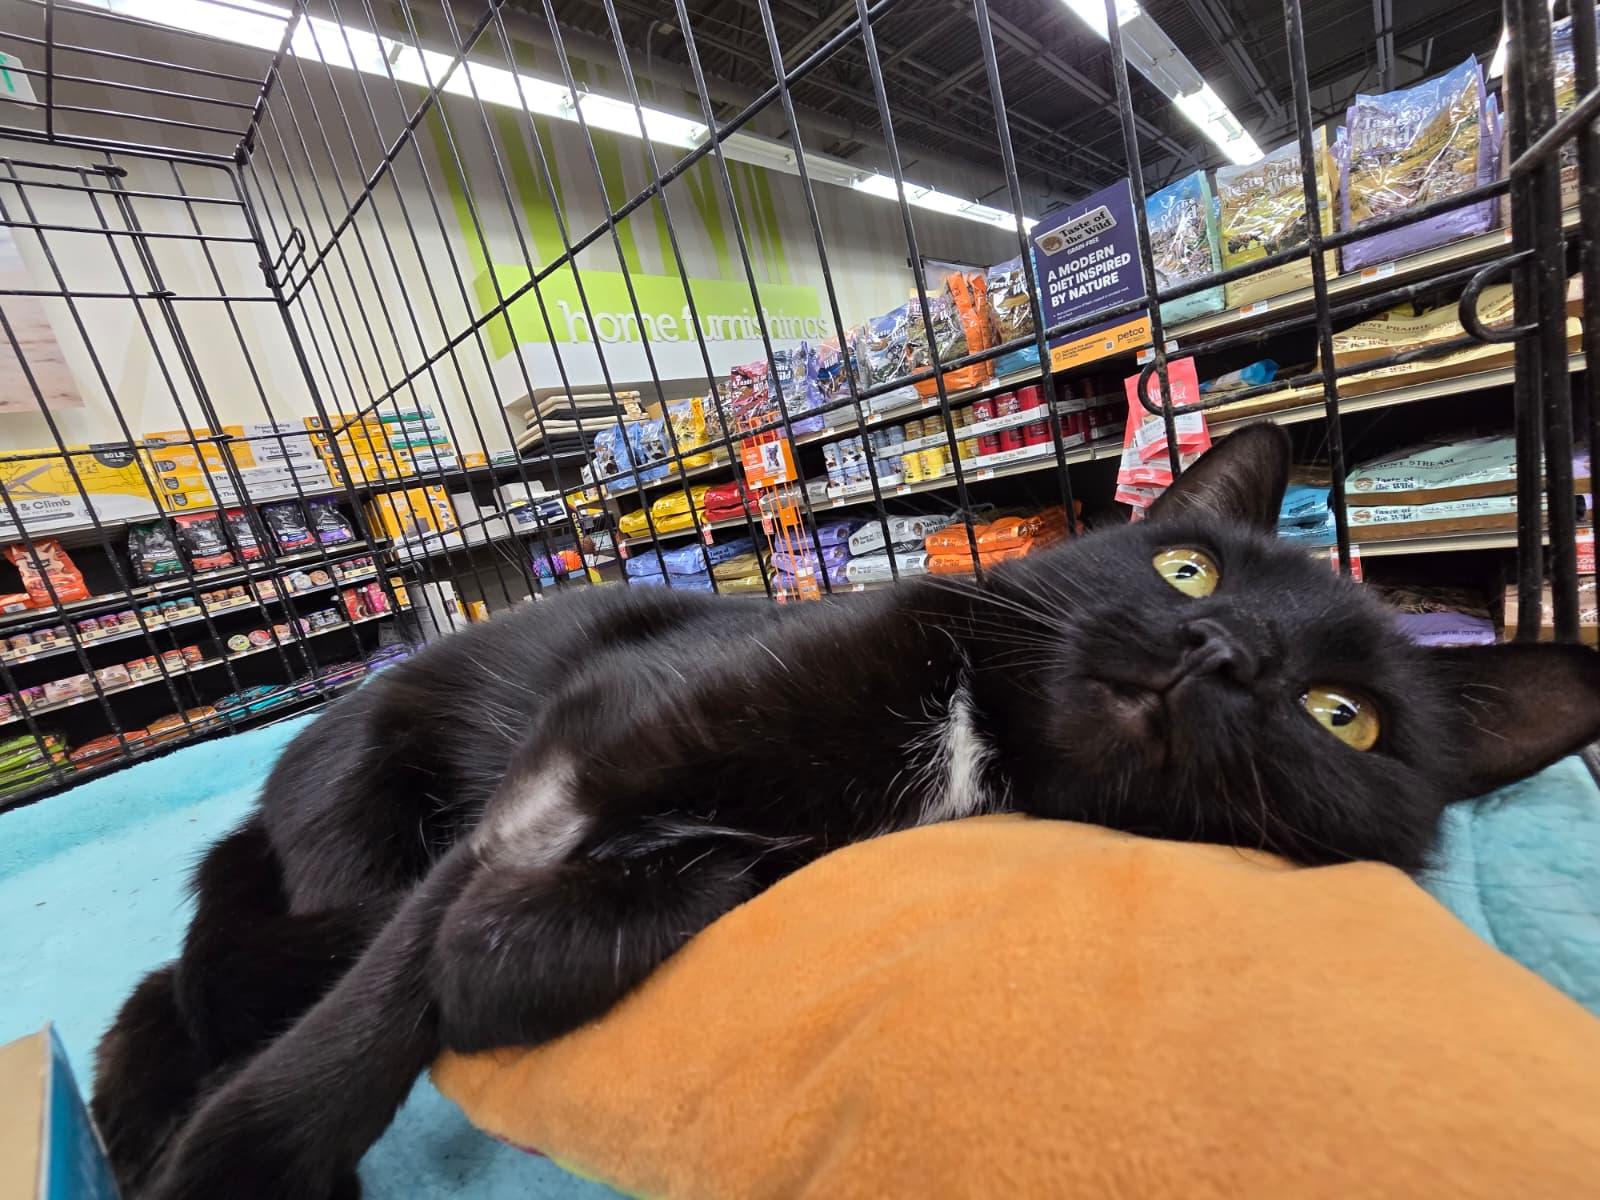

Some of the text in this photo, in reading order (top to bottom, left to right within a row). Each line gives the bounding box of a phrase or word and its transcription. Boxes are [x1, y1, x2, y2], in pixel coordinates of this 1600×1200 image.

[1060, 211, 1106, 238] Taste of
[1066, 219, 1112, 245] the Wild
[1048, 244, 1115, 283] A MODERN
[1049, 253, 1131, 295] DIET INSPIRED
[1051, 292, 1066, 308] BY
[1069, 271, 1119, 301] NATURE
[557, 299, 829, 344] home furnishings
[1117, 327, 1145, 343] petco
[1409, 458, 1455, 468] STREAM
[20, 503, 31, 511] &
[33, 498, 71, 510] Climb
